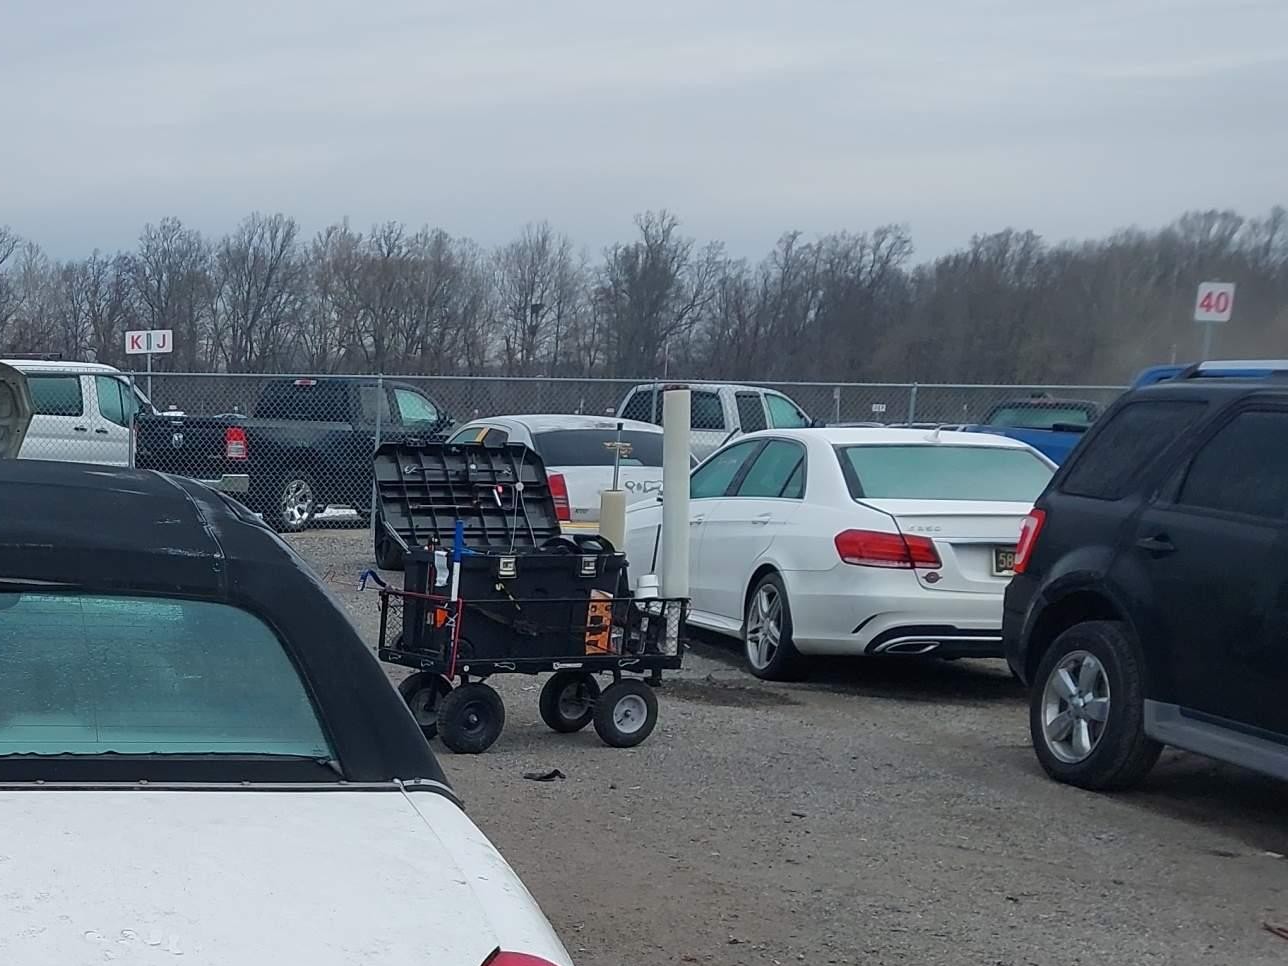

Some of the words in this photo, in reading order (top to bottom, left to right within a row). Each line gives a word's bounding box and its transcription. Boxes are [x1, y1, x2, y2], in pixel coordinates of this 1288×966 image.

[1199, 291, 1230, 314] 40
[131, 334, 143, 350] K
[156, 334, 166, 349] J
